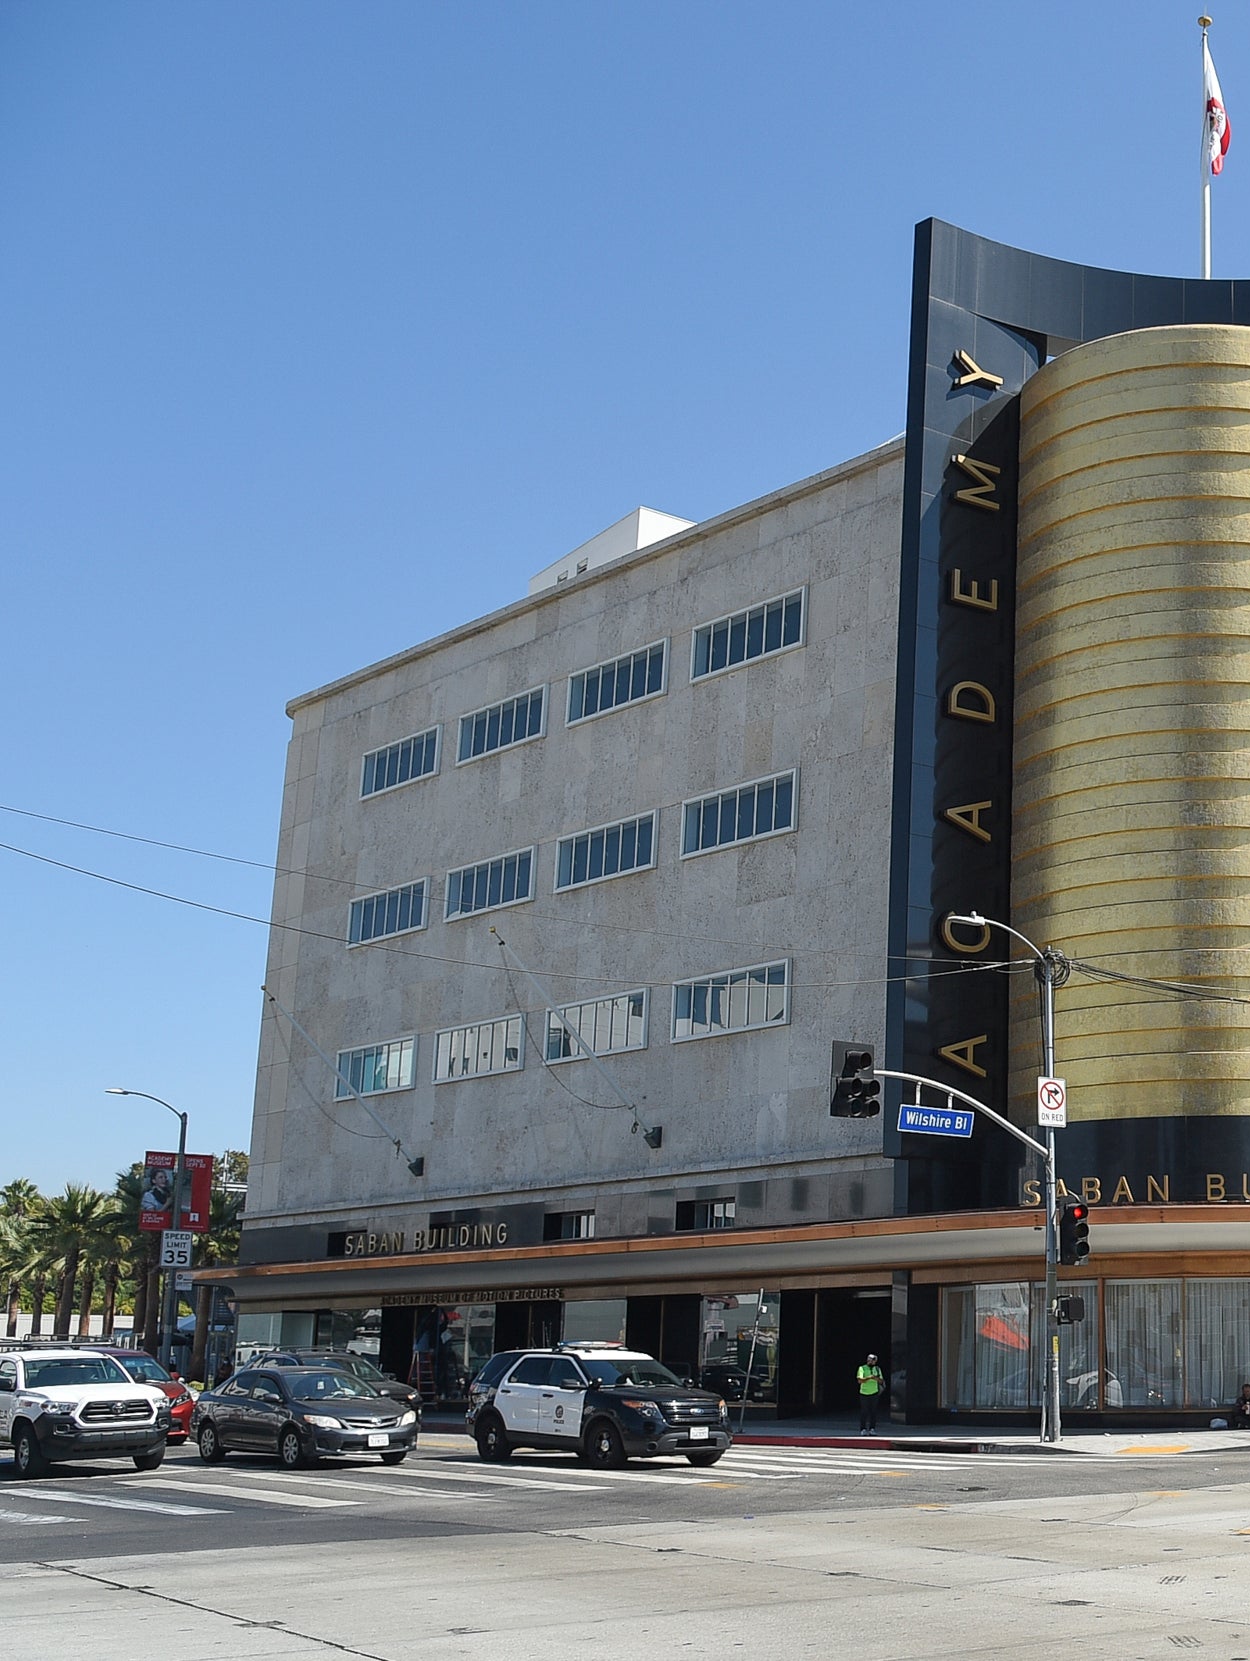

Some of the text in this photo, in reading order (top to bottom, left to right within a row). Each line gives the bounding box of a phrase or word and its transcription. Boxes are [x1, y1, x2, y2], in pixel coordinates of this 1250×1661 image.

[938, 349, 1004, 1078] ACADEMY
[906, 1111, 968, 1130] Wilshire Bl
[1041, 1112, 1064, 1122] ON RED
[164, 1232, 191, 1240] SPEED
[345, 1222, 508, 1255] SABAN BUILDING
[166, 1241, 188, 1249] LIMIT
[163, 1250, 188, 1264] 35
[420, 1292, 457, 1304] MUSEUM
[461, 1292, 471, 1303] OF
[474, 1289, 510, 1302] MOTION
[513, 1288, 561, 1301] PICTURES
